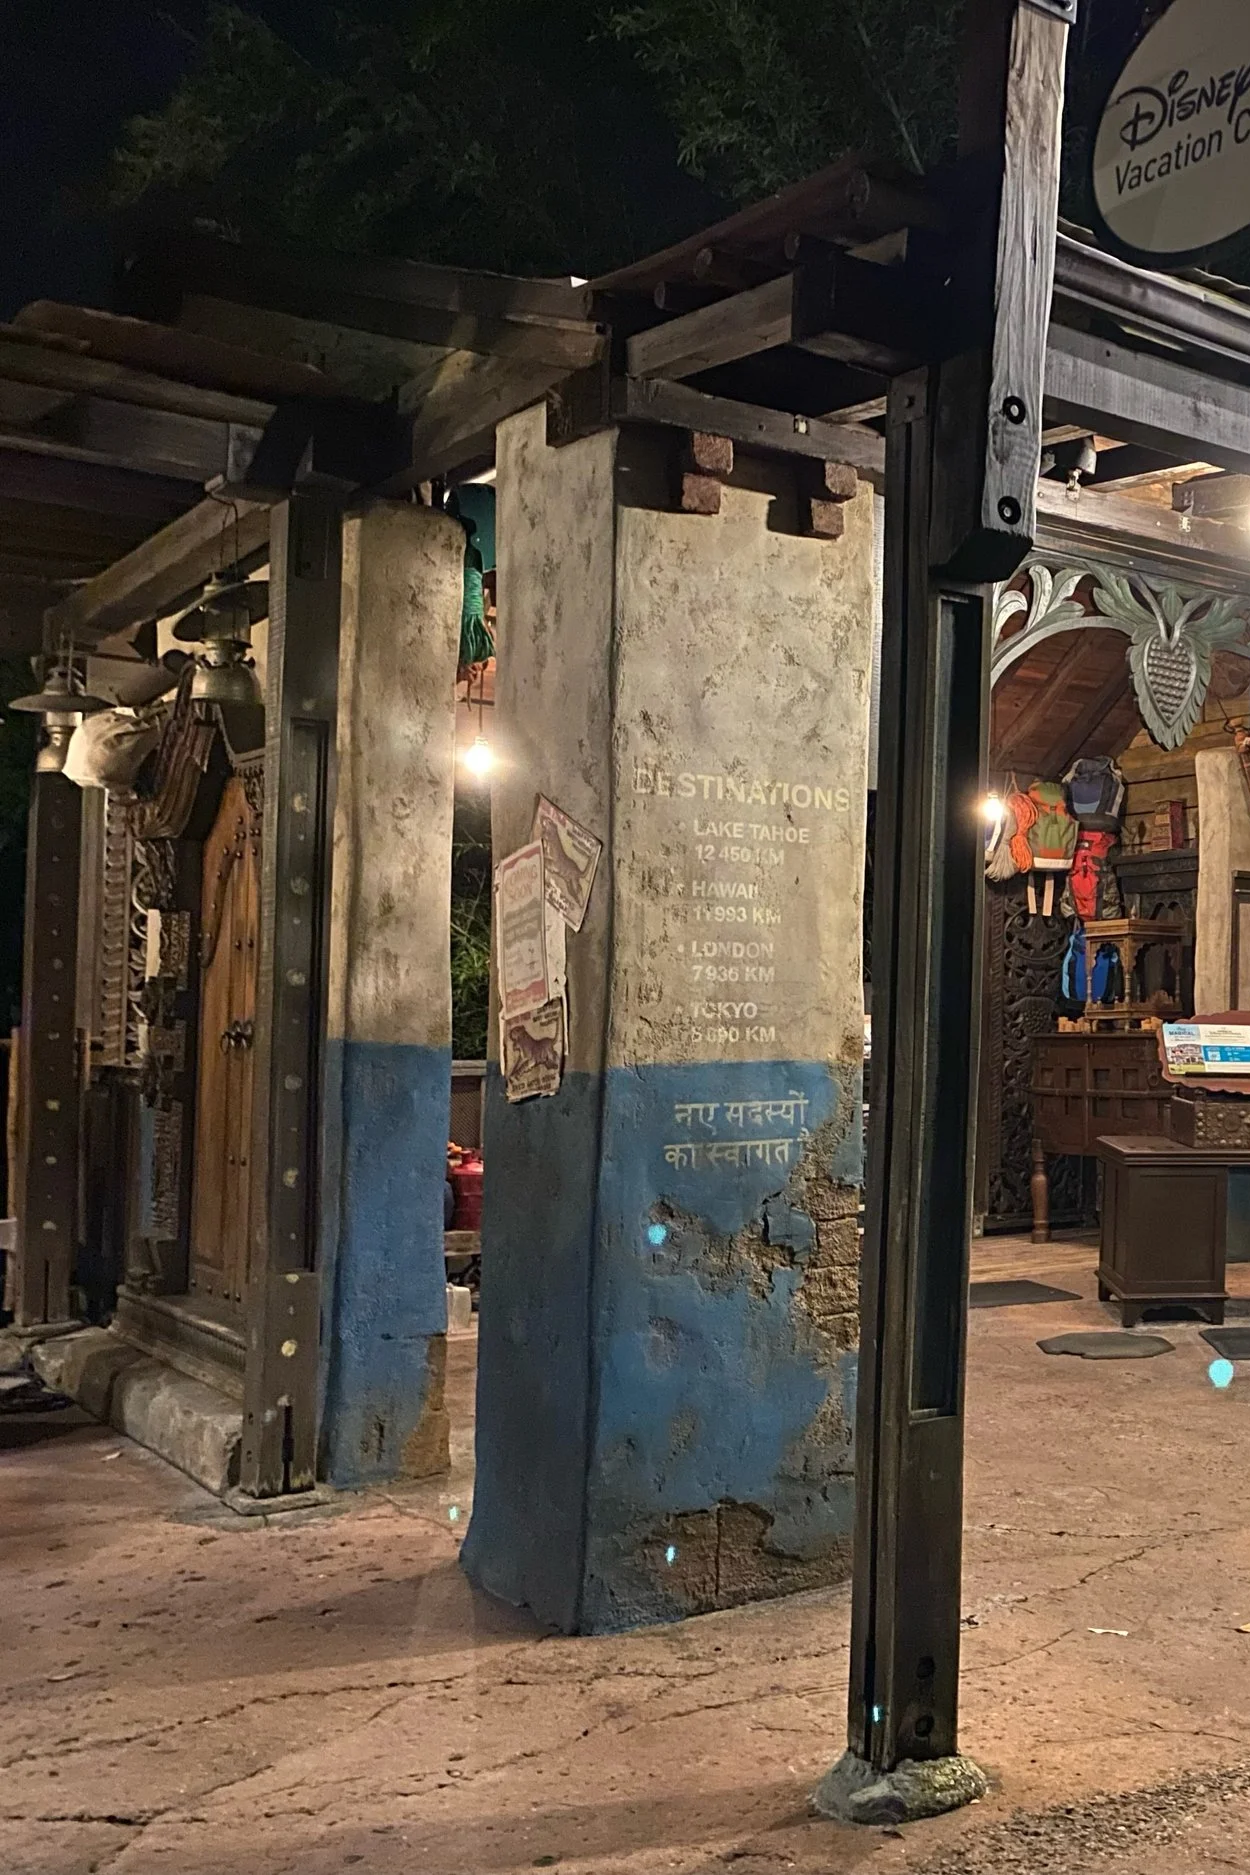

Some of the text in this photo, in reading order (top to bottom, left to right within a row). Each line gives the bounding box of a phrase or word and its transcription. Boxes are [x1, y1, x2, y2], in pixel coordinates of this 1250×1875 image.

[1115, 130, 1223, 195] Vacation
[633, 768, 850, 811] DESTINATIONS
[693, 820, 810, 844] LAKE TAHOE
[755, 847, 785, 866] KM
[691, 881, 759, 900] HAWAII
[752, 907, 782, 925] KM
[691, 942, 773, 957] LONDON
[744, 966, 775, 983] KM
[691, 1003, 758, 1018] TOKYO
[745, 1025, 776, 1043] KM
[674, 1102, 720, 1136] नए
[664, 1143, 697, 1170] का
[702, 1138, 794, 1168] स्वागत
